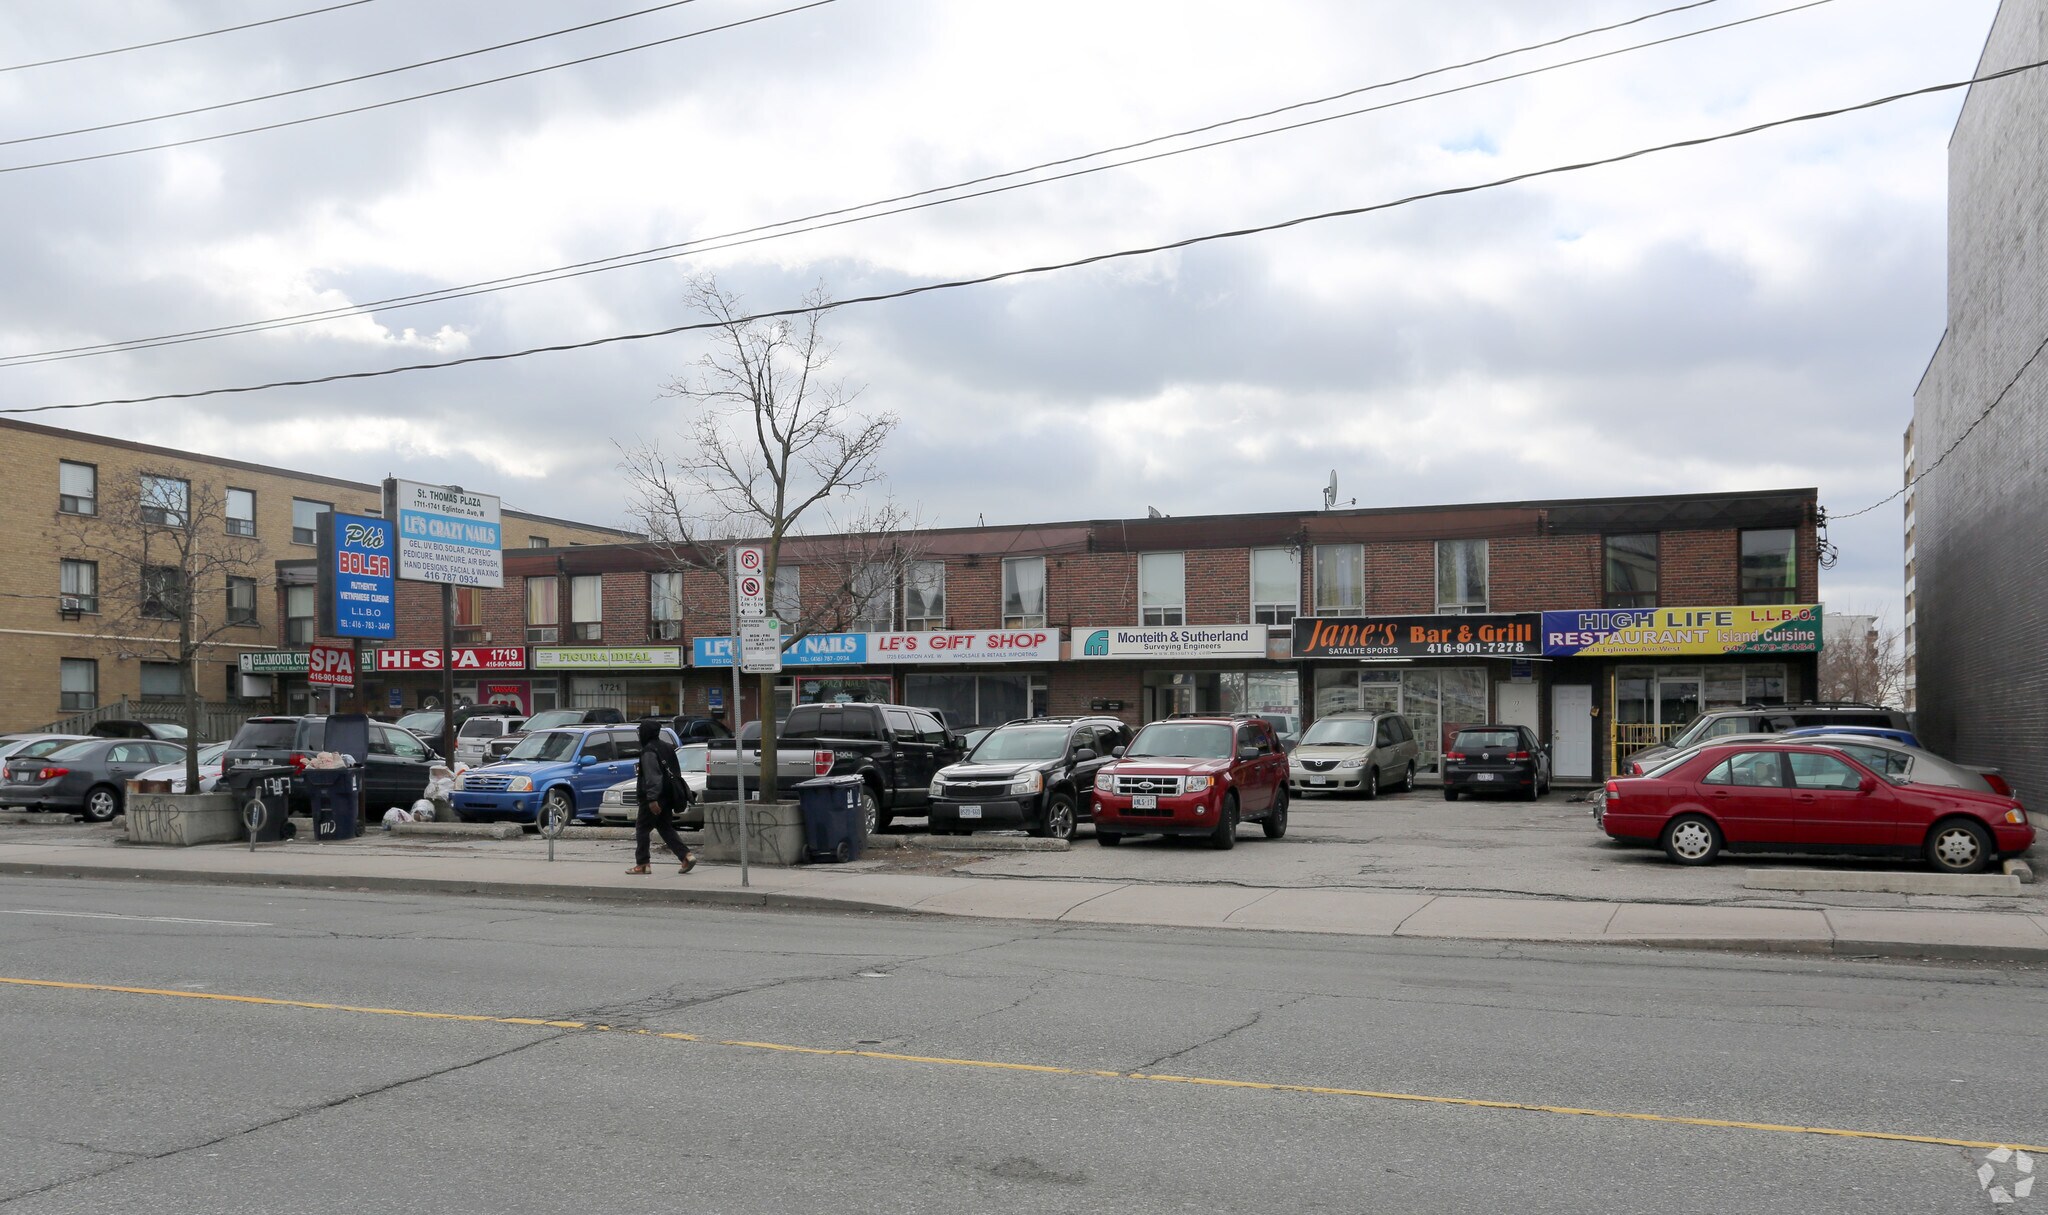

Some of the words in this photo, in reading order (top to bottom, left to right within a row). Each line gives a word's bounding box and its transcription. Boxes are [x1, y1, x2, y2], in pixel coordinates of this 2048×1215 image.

[430, 491, 458, 504] THOMAS
[460, 496, 481, 507] PLAZA
[414, 500, 440, 510] 1711-1741
[442, 505, 464, 514] Eglinton
[404, 515, 426, 536] LE'S
[428, 519, 464, 540] CRAZY
[466, 523, 496, 545] NAILS
[404, 550, 434, 561] PEDICURE,
[435, 554, 467, 564] MANICURE,
[467, 548, 491, 557] ACRYLIC
[339, 550, 390, 579] BOLSA
[404, 560, 421, 569] HAND
[422, 563, 449, 573] DESIGNS,
[450, 566, 471, 575] FACIAL
[476, 569, 499, 578] WAXING
[424, 571, 440, 580] 416
[442, 573, 456, 582] 787
[459, 575, 478, 584] 0934
[350, 581, 377, 591] AUTHENTIC
[340, 591, 370, 602] VIETNAMESE
[371, 594, 389, 604] CUISINE
[352, 608, 381, 617] L.L.B.O
[1578, 612, 1654, 630] HIGH
[1667, 611, 1733, 628] LIFE
[1750, 609, 1815, 622] L.L.B.O.
[878, 636, 917, 652] LE'S
[929, 634, 976, 650] GIFT
[987, 633, 1047, 649] SHOP
[1117, 632, 1167, 643] Monteith
[1170, 632, 1178, 642] &
[1181, 630, 1248, 642] Sutherland
[1303, 620, 1398, 652] Jane's
[1410, 626, 1451, 643] Bar
[1457, 625, 1472, 642] &
[1478, 623, 1531, 642] Grill
[1549, 629, 1709, 646] RESTAURANT
[1717, 629, 1758, 643] Island
[1763, 628, 1815, 642] Cuisine
[806, 636, 857, 655] NAILS
[1144, 643, 1182, 651] Surveying
[1426, 642, 1524, 653] 416-901-7278
[1722, 644, 1815, 652] 647-479-5484
[253, 653, 293, 665] GLAMOUR
[490, 649, 518, 660] 1719
[559, 652, 608, 662] FIGURA
[611, 652, 651, 662] IDEAL
[310, 649, 352, 674] SPA
[310, 673, 352, 683] 416-901-8688
